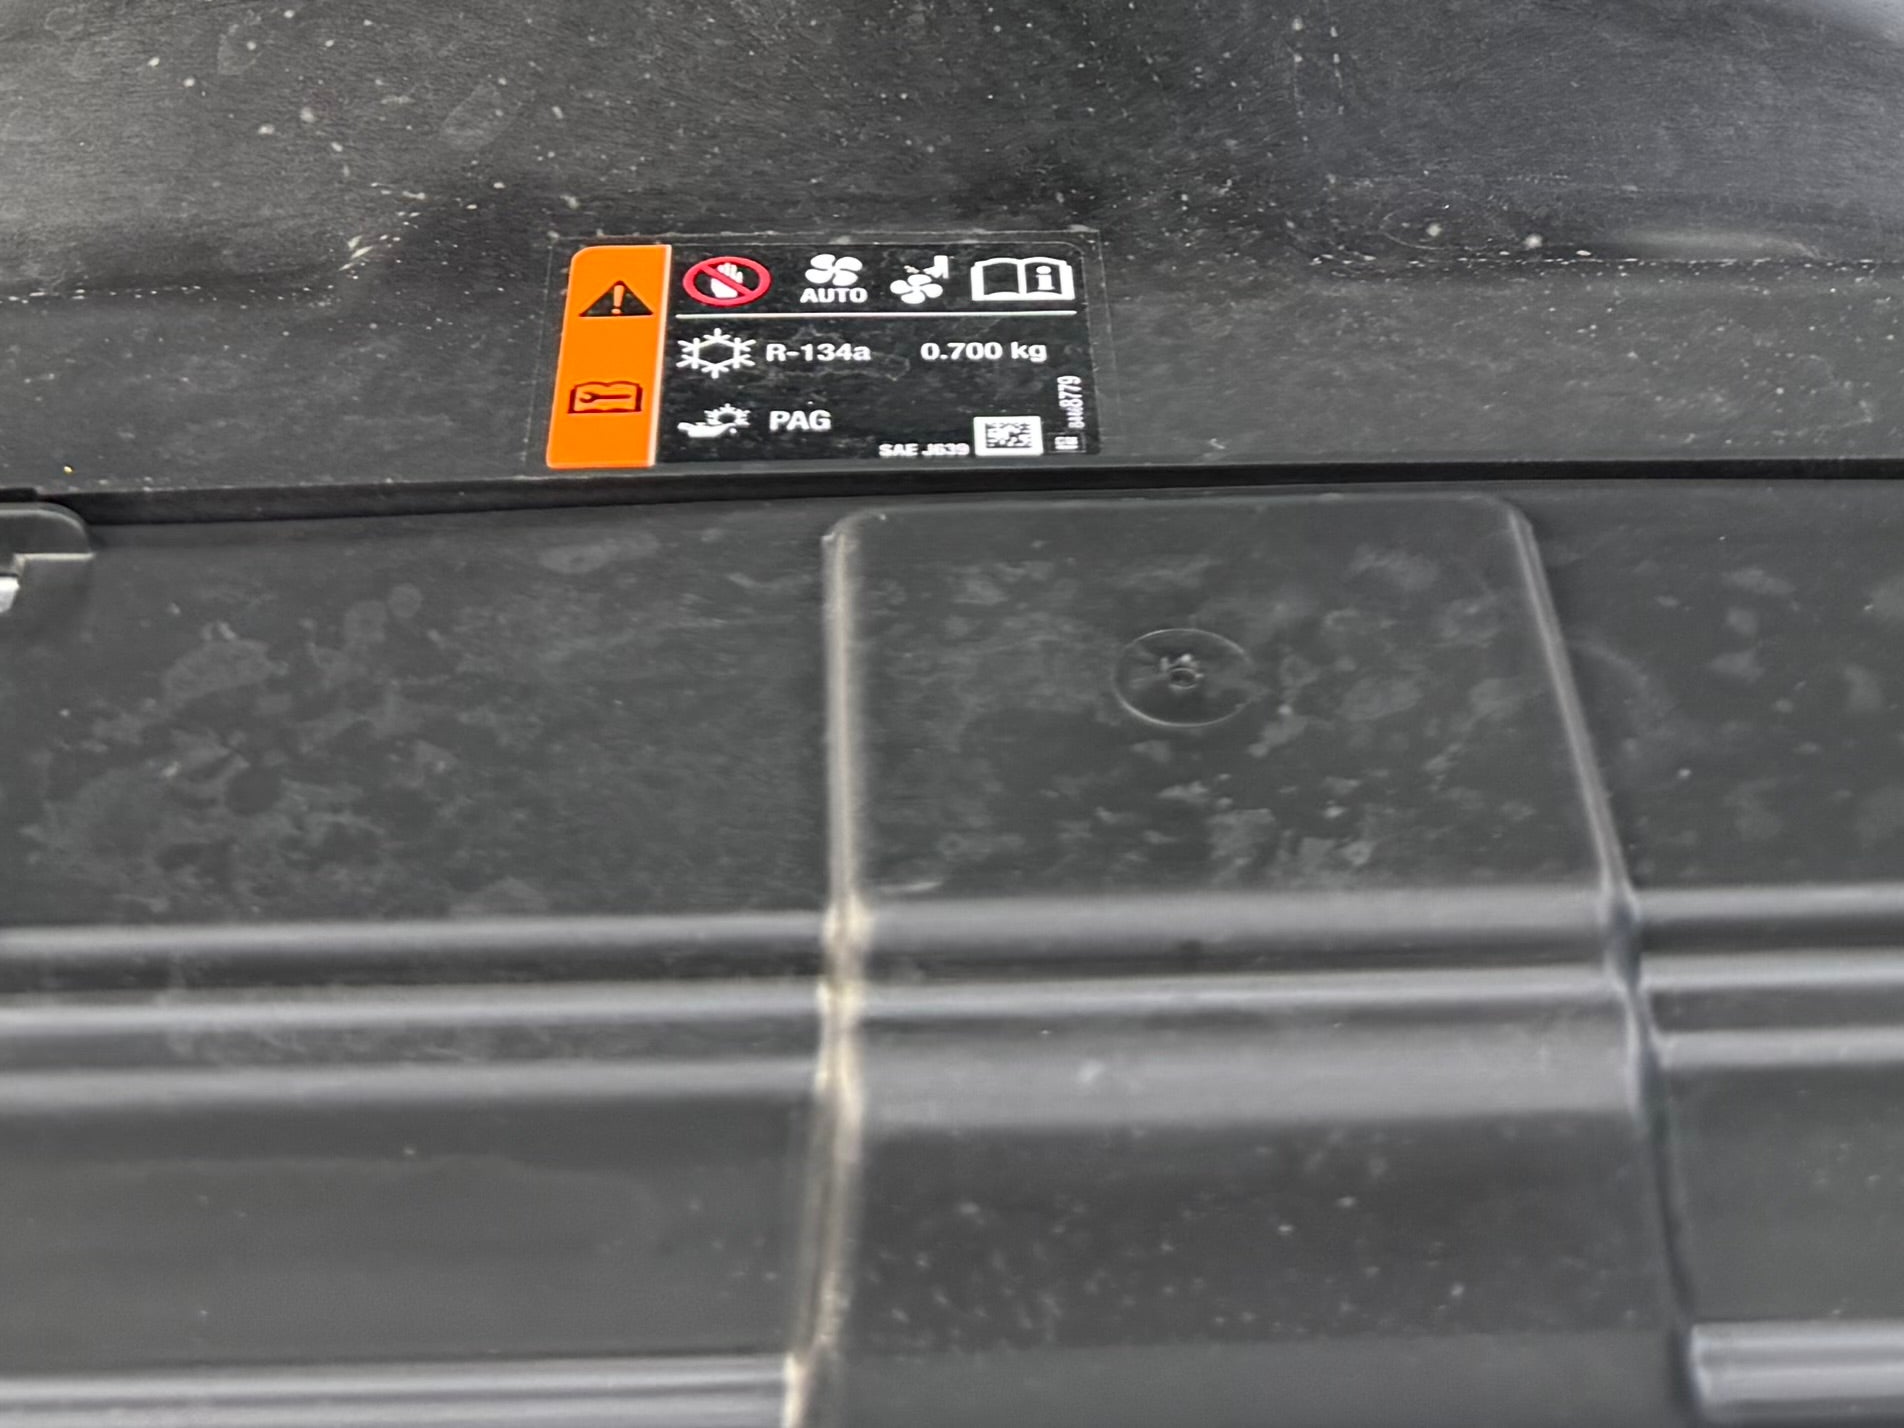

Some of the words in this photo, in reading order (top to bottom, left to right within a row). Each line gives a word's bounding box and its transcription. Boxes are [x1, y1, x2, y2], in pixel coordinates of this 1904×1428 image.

[800, 286, 868, 305] AUTO
[766, 341, 872, 363] R-134a
[920, 341, 1004, 362] 0.700
[1011, 340, 1048, 365] kg
[769, 410, 832, 432] PAG
[879, 442, 919, 457] SAE
